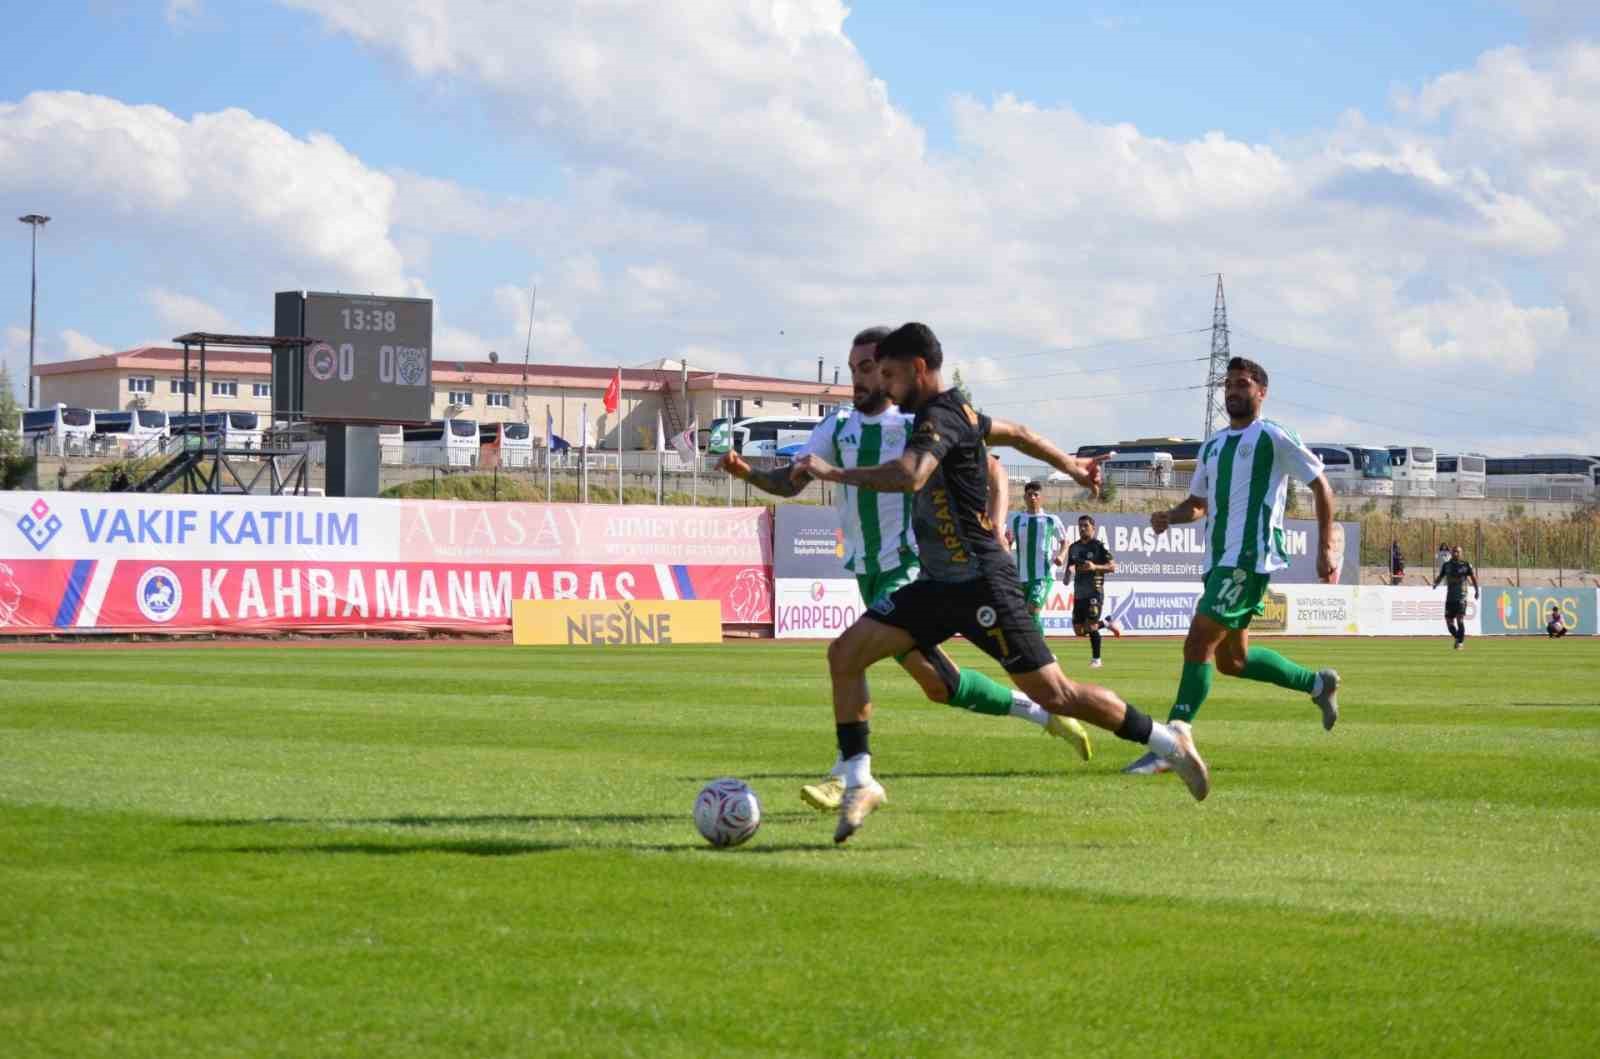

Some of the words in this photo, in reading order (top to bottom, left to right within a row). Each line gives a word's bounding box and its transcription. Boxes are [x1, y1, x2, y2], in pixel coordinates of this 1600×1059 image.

[340, 308, 396, 332] 13:38
[80, 508, 198, 544] VAKIF
[209, 510, 358, 546] KATILIM
[1114, 526, 1206, 557] BAŞARIL
[1217, 577, 1243, 607] 14
